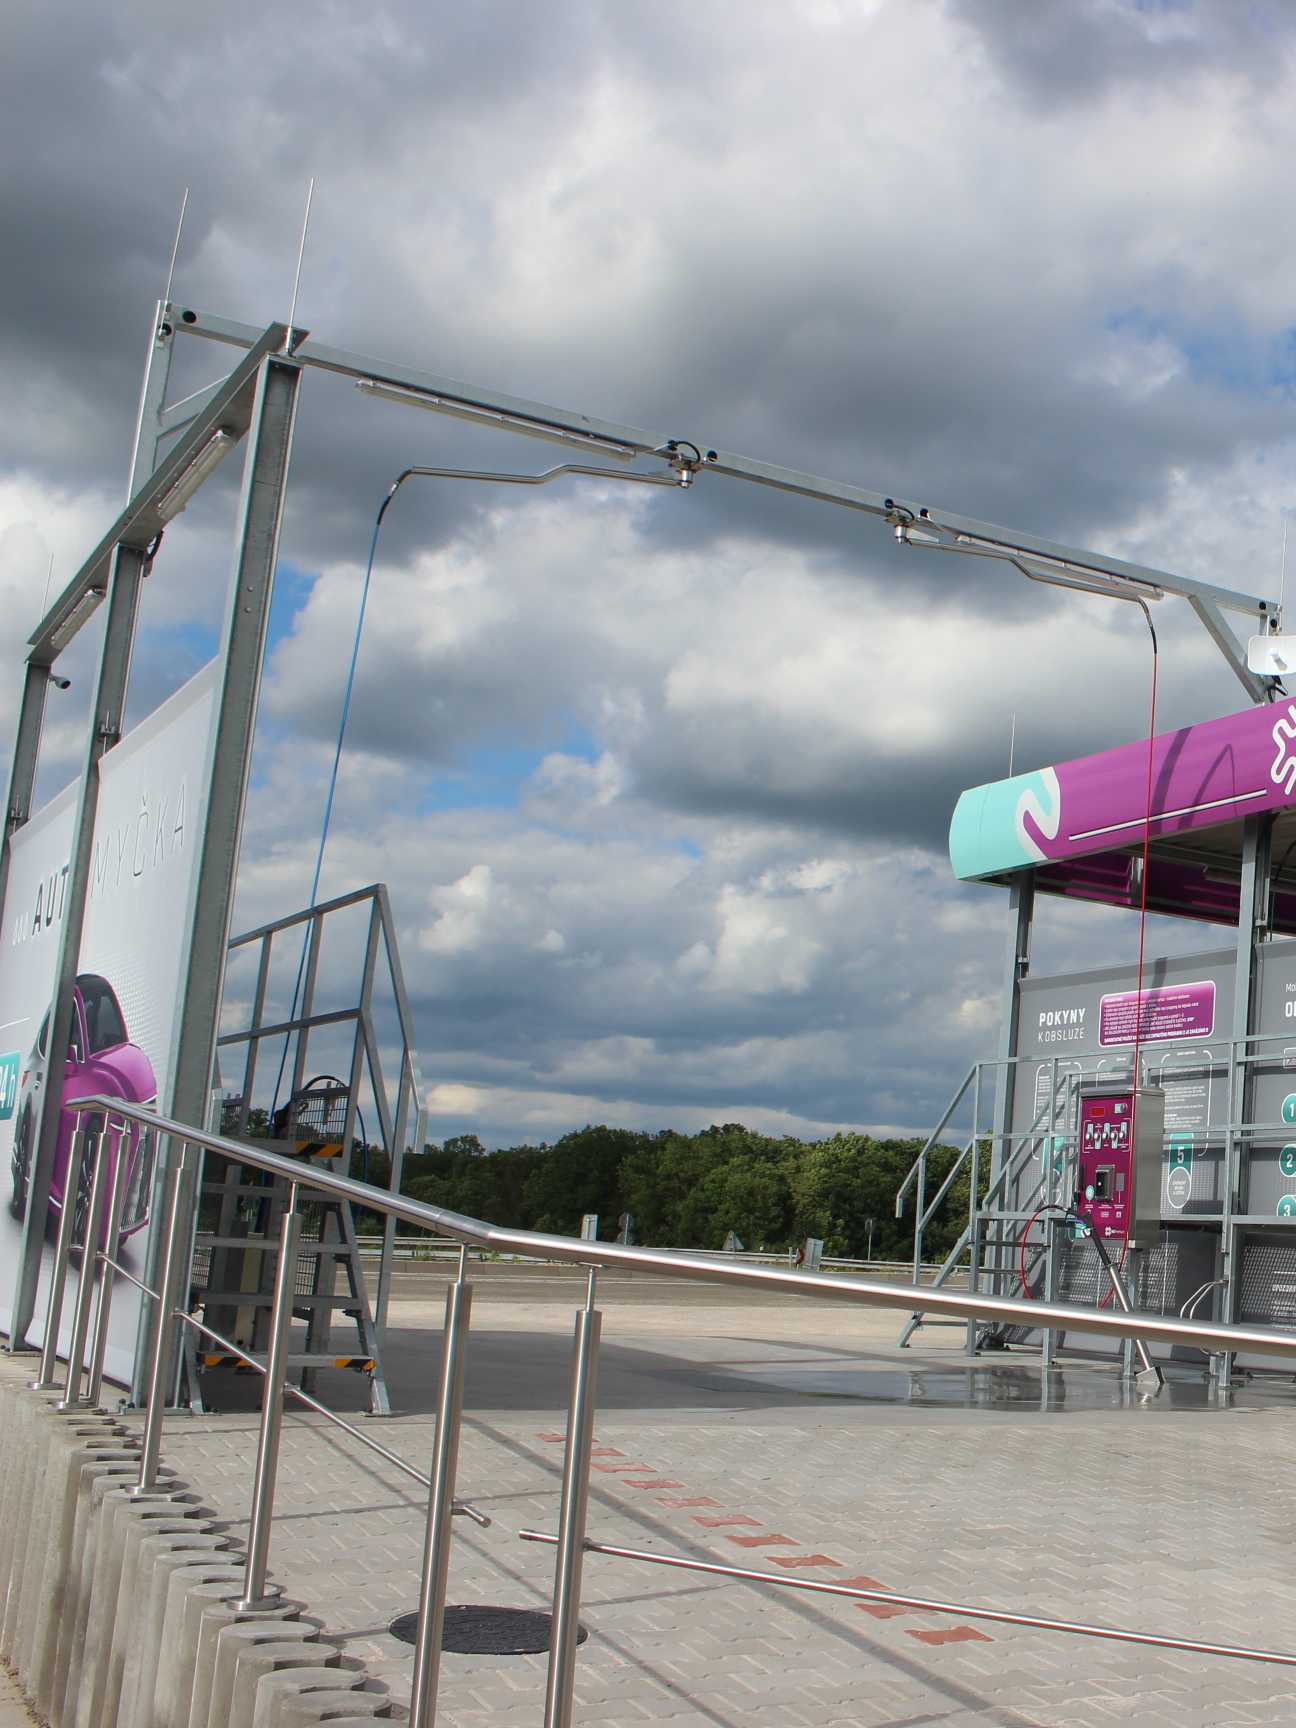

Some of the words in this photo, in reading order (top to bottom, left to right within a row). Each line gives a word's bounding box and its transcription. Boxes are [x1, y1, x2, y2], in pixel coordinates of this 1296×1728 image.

[1039, 1008, 1086, 1027] POKYNY
[1038, 1031, 1044, 1043] K
[1044, 1027, 1085, 1042] OBSLUZE
[0, 1063, 16, 1109] 4h
[1290, 1103, 1295, 1117] 1
[1177, 1146, 1185, 1164] 5
[1286, 1153, 1294, 1168] 2
[1283, 1204, 1291, 1216] 3
